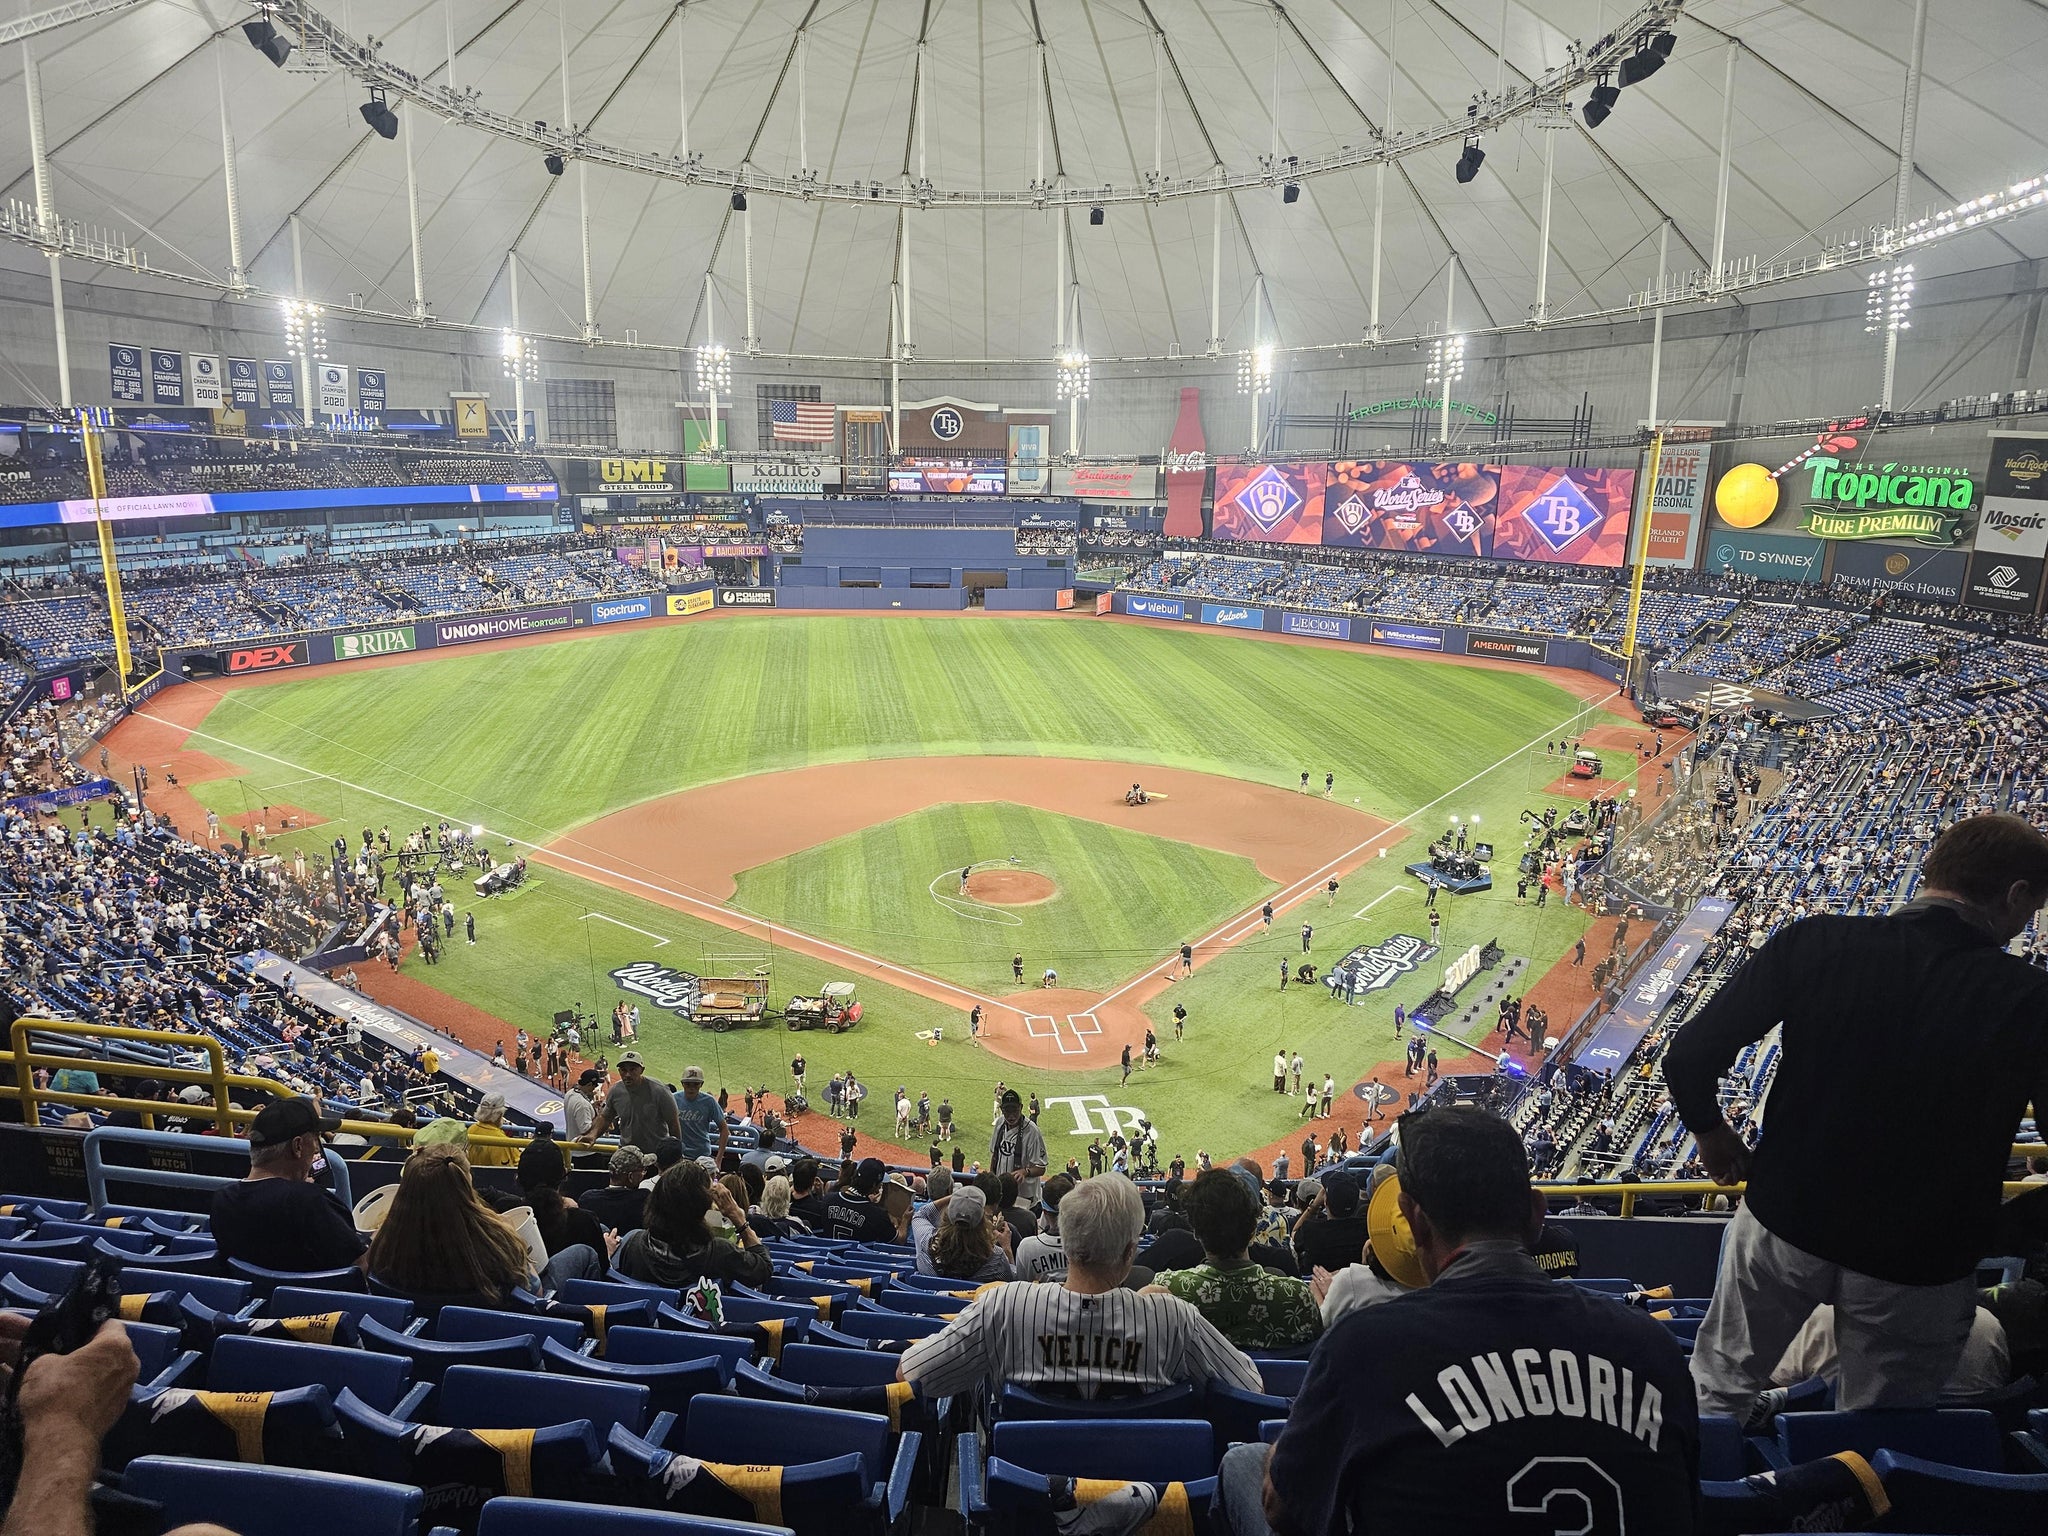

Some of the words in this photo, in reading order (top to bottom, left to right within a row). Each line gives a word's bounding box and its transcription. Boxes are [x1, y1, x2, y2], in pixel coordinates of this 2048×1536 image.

[157, 385, 180, 396] 2008
[197, 389, 218, 399] 2008
[236, 392, 256, 402] 2010
[272, 393, 292, 403] 2020
[324, 397, 345, 406] 2020
[364, 400, 382, 410] 2021
[1350, 398, 1443, 421] TROPICANA
[1450, 400, 1497, 425] FIELD
[936, 413, 958, 435] TB
[601, 460, 668, 482] GMF
[1844, 463, 1874, 471] THE
[1902, 466, 1969, 476] ORIGINAL
[2005, 458, 2026, 468] Hard
[2028, 460, 2048, 471] Rock
[1804, 457, 1974, 510] Tropicana
[1374, 489, 1412, 506] World
[1410, 488, 1445, 511] Series
[1050, 520, 1076, 528] PORCH
[1453, 510, 1474, 532] TB
[1540, 496, 1580, 535] TB
[1811, 514, 1856, 534] PURE
[1858, 514, 1943, 533] PREMIUM
[1984, 510, 2046, 529] Mosaic
[747, 546, 763, 555] DECK
[1739, 550, 1755, 560] TD
[1758, 552, 1813, 567] SYNNEX
[1834, 574, 1870, 586] DREAM
[1873, 578, 1915, 592] FINDERS
[1917, 583, 1956, 597] HOMES
[597, 604, 642, 618] Spectrum
[1148, 602, 1178, 614] Webull
[1216, 610, 1248, 623] Culver's
[360, 631, 409, 654] RIPA
[1473, 640, 1516, 652] AMERANT
[1516, 646, 1539, 655] BANK
[230, 644, 296, 671] DEX
[1367, 936, 1421, 970] Series
[1044, 1094, 1158, 1145] TB
[47, 1145, 81, 1158] WATCH
[56, 1157, 75, 1167] OUT
[152, 1158, 186, 1169] WATCH
[828, 1206, 866, 1227] FRANCO
[1038, 1334, 1143, 1372] YELICH
[1405, 1348, 1663, 1452] LONGORIA
